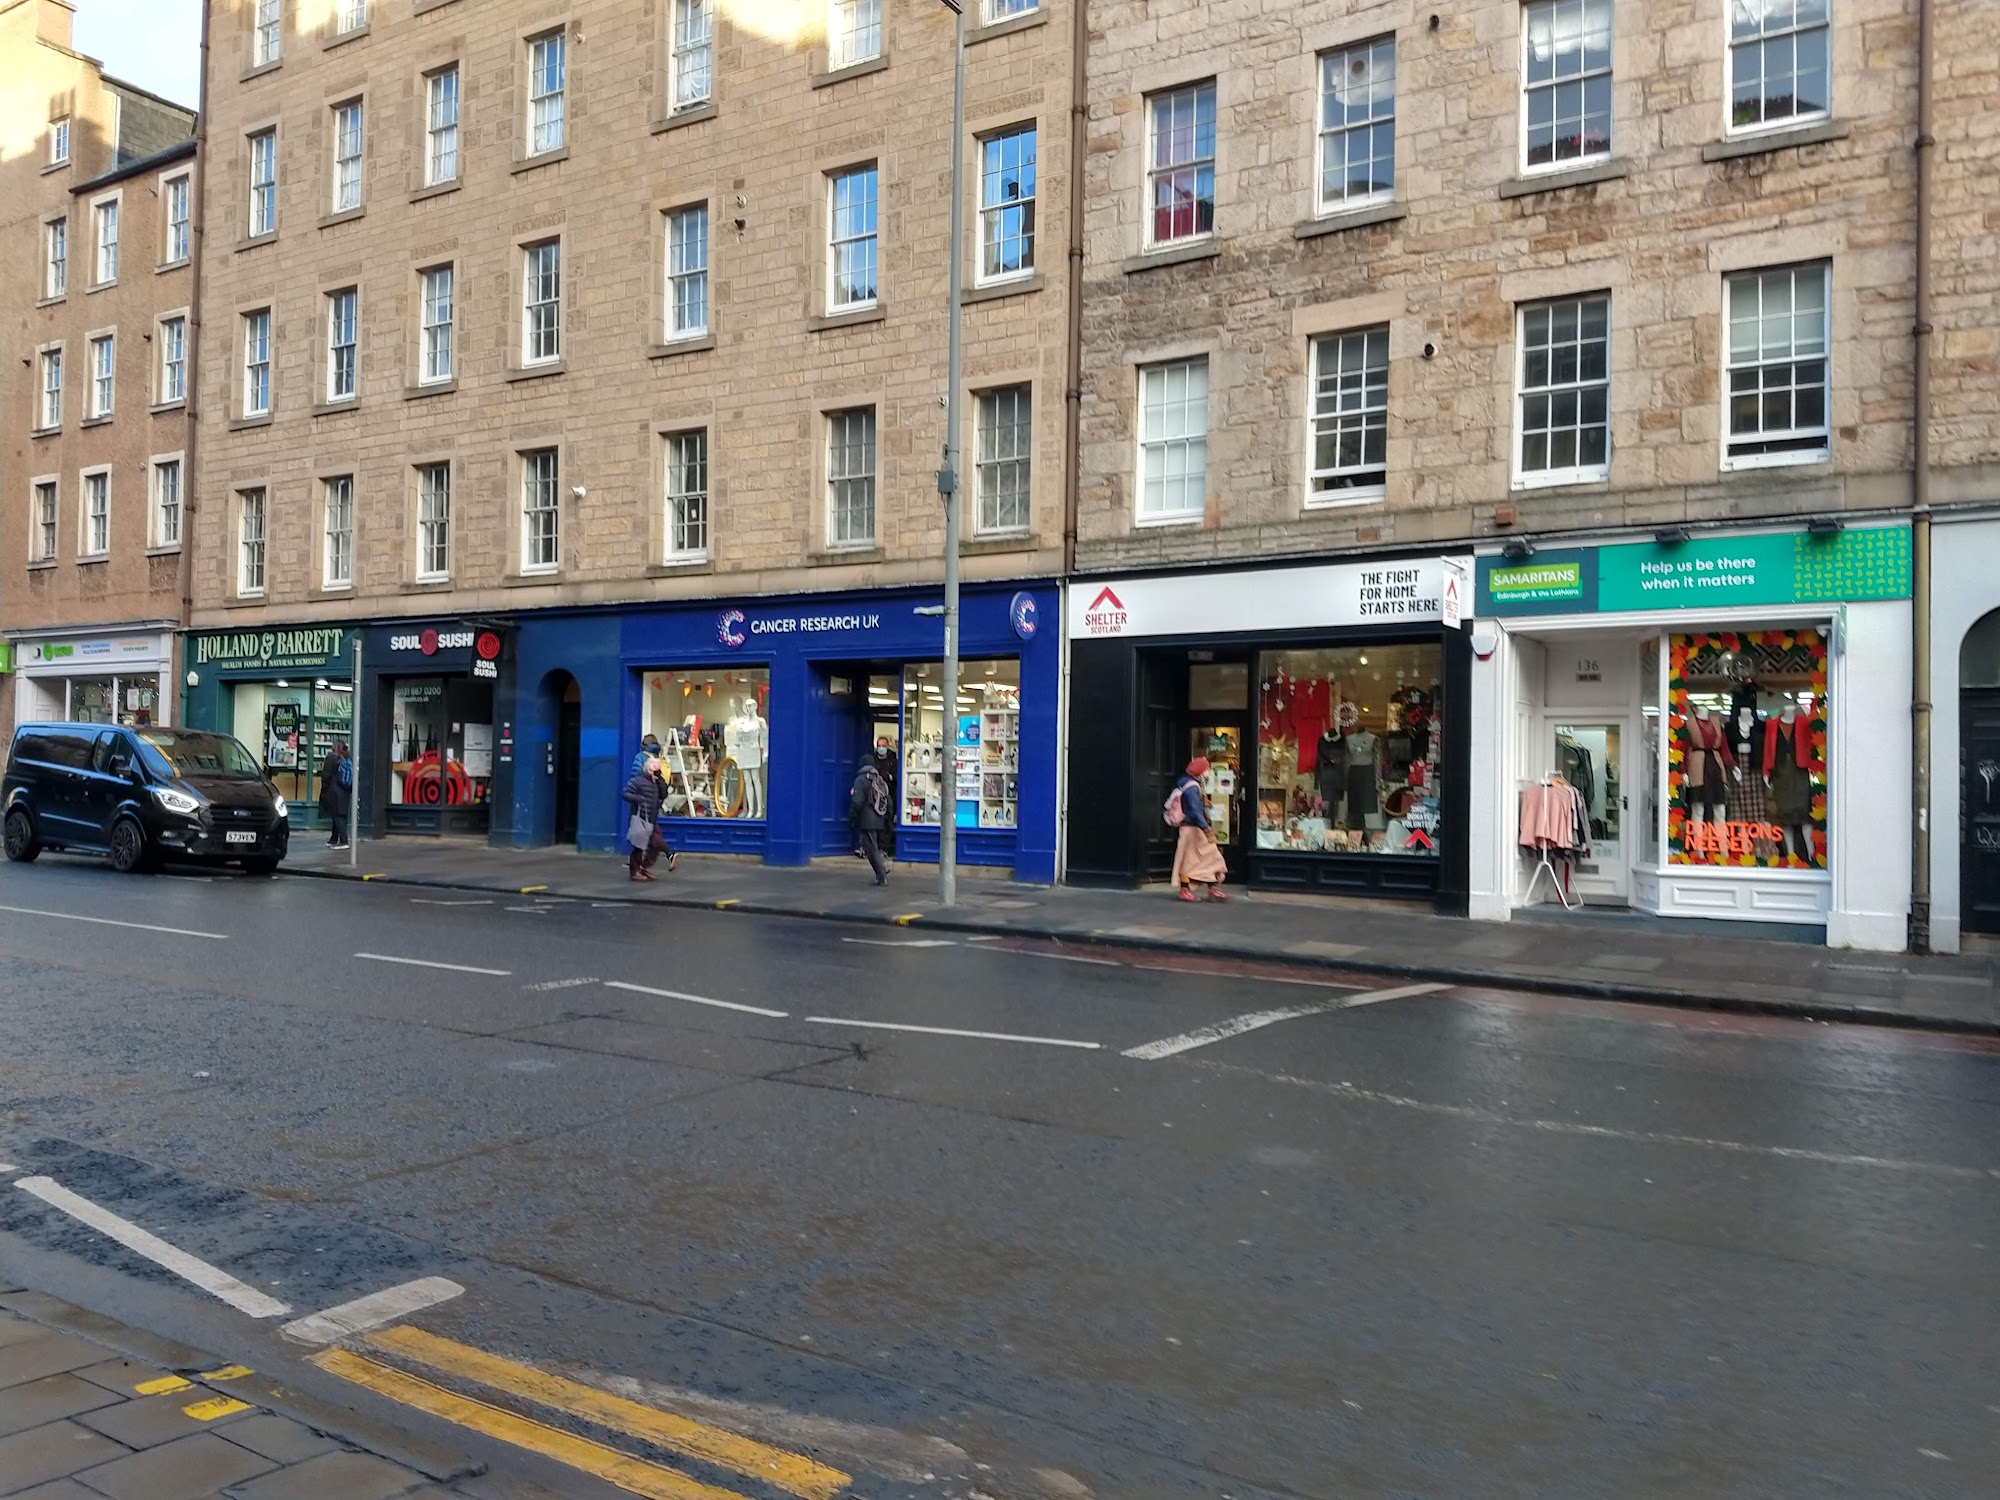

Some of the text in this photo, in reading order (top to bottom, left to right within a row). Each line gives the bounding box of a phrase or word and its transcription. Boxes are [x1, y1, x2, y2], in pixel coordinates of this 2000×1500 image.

[1640, 556, 1756, 575] Help us be there
[1360, 569, 1420, 586] THE FIGHT
[1493, 569, 1576, 586] SAMARITANS
[1641, 574, 1755, 590] when it matters
[1360, 585, 1417, 600] FOR HOME
[1497, 588, 1579, 600] Edinburgh & the Lothians
[1360, 601, 1404, 616] STARTS
[1408, 598, 1439, 613] HERE
[751, 614, 880, 634] CANCER RESEARCH UK
[1085, 612, 1127, 626] SHELTER
[1090, 625, 1121, 634] SCOTLAND
[197, 628, 343, 663] HOLLAND & BARRETT
[390, 632, 474, 651] SOUL SUSHI
[268, 658, 295, 667] NATURAL
[476, 659, 496, 670] SOUL
[1578, 659, 1599, 671] 136
[474, 668, 498, 678] SUSHI
[276, 726, 293, 734] EVENT
[1685, 820, 1784, 842] DONATIONS
[1684, 835, 1754, 853] NEEDED
